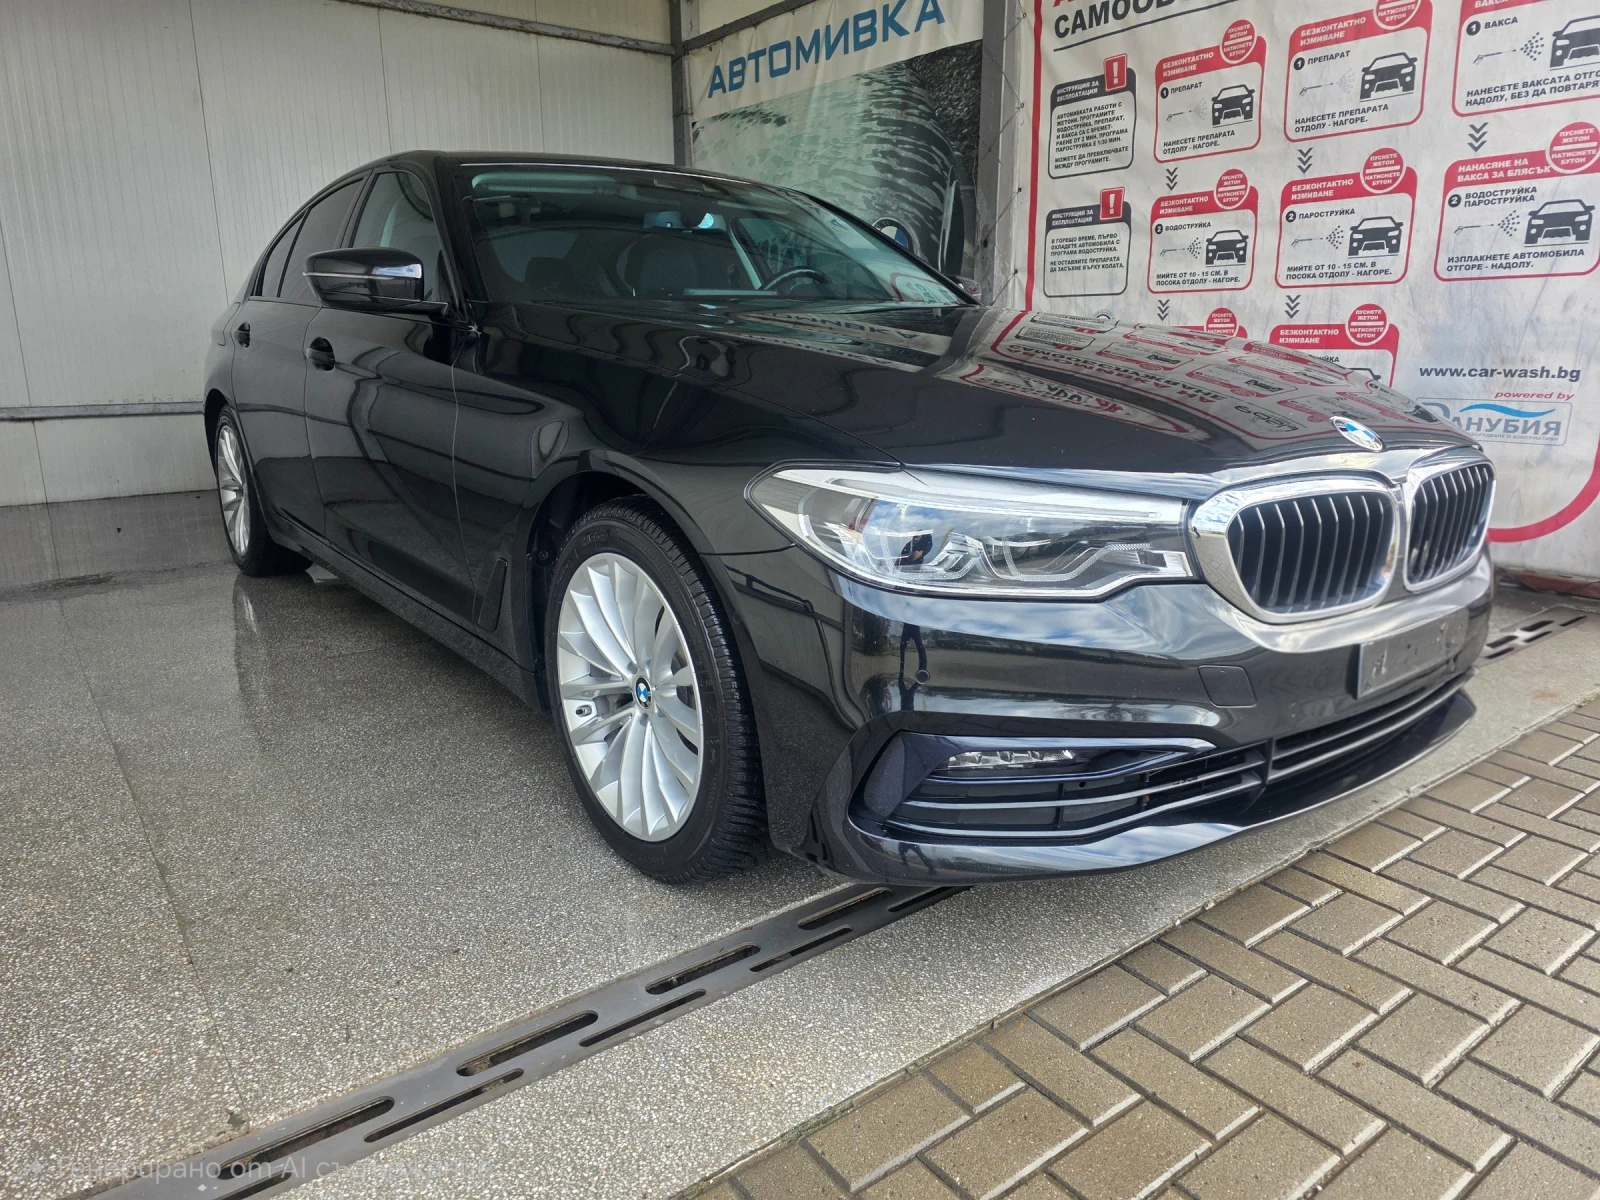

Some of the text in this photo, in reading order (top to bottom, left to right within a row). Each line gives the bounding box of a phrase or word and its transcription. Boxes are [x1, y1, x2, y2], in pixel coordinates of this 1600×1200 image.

[1378, 3, 1416, 17] НАТИСНЕТЕ
[1054, 0, 1175, 38] САМОО
[1385, 13, 1406, 22] БУТОН
[1484, 16, 1518, 29] ВАКСА
[1228, 24, 1250, 34] ПУСНЕТЕ
[1300, 17, 1366, 37] БЕЗКОНТАКТНО
[1229, 31, 1248, 39] ЖЕТОН
[1300, 31, 1345, 46] ИЗМИВАНЕ
[707, 0, 946, 98] АВТОМИВКА
[1224, 41, 1252, 53] НАТИСНЕТЕ
[1229, 49, 1245, 57] БУТОН
[1307, 50, 1351, 65] ПРЕПАРАТ
[1163, 52, 1214, 69] БЕЗКОНТАКТНО
[1163, 64, 1197, 77] ИЗМИВАНЕ
[1057, 82, 1090, 95] ИНСТРУКЦИЯ
[1171, 82, 1202, 94] ПРЕПАРАТ
[1467, 82, 1519, 97] НАНЕСЕТЕ
[1522, 75, 1571, 89] ВАКСАТА
[1057, 88, 1098, 102] ЕКСПЛОАТАЦИЯ
[1465, 80, 1600, 107] НАДОЛУ, БЕЗ ДА ПОВТАРЯ
[1057, 103, 1117, 120] АВТОМИВКАТА РАБОТИ
[1079, 110, 1115, 121] ПРОГРАМИТЕ
[1295, 104, 1388, 125] НАНЕСЕТЕ ПРЕПАРАТА
[1094, 115, 1125, 126] ПРЕПАРАТ,
[1295, 116, 1368, 133] ОТДОЛУ НАГОРЕ.
[1061, 131, 1078, 139] ВАКСА
[1086, 134, 1098, 142] МИН.
[1099, 128, 1128, 138] ПРОГРАМА
[1559, 128, 1595, 137] ПУСНЕТЕ
[1164, 130, 1235, 147] НАНЕСЕТЕ ПРЕПАРАТА
[1562, 135, 1590, 144] ЖЕТОН
[1055, 142, 1092, 152] ПАРОСТРУЙКА
[1163, 140, 1220, 155] ОТДОЛУ НАГОРЕ.
[1055, 155, 1077, 163] МОЖЕТЕ
[1087, 146, 1129, 158] ПРЕВКЛЮЧВАТЕ
[1370, 153, 1398, 161] ПУСНЕТЕ
[1552, 149, 1597, 159] НАТИСНЕТЕ
[1074, 157, 1110, 167] ПРОГРАМИТЕ.
[1372, 159, 1395, 167] ЖЕТОН
[1458, 158, 1528, 172] НАНАСЯНЕ НА
[1561, 157, 1586, 165] БУТОН
[1364, 172, 1400, 180] НАТИСНЕТЕ
[1457, 166, 1551, 182] ВАКСА ЗА БЛЯСЪК
[1292, 179, 1354, 192] БЕЗКОНТАКТНО
[1291, 190, 1334, 200] ИЗМИВАНЕ
[1465, 186, 1537, 199] ВОДОСТРУЙКА
[1161, 196, 1208, 207] БЕЗКОНТАКТНО
[1464, 194, 1535, 208] ПАРОСТРУЙКА
[1052, 210, 1085, 219] ИНСТРУКЦИЯ
[1160, 206, 1193, 215] ИЗМИВАНЕ
[1299, 208, 1355, 219] ПАРОСТРУЙКА
[1052, 217, 1092, 226] ЕКСПЛОАТАЦИЯ
[1165, 222, 1211, 231] ВОДОСТРУЙКА
[1051, 240, 1114, 250] ОХЛАДЕТЕ АВТОМОБИЛА
[1078, 246, 1118, 255] ВОДОСТРУЙКА.
[1447, 249, 1585, 263] ИЗПЛАКНЕТЕ АВТОМОБИЛА
[1287, 264, 1312, 272] МИЙТЕ
[1446, 261, 1534, 272] ОТГОРЕ НАДОЛУ.
[1318, 271, 1350, 279] ОТДОЛУ
[1182, 278, 1207, 286] ОТДОЛУ
[1419, 366, 1581, 382] www.car-wash.bg
[1494, 391, 1574, 401] powered by
